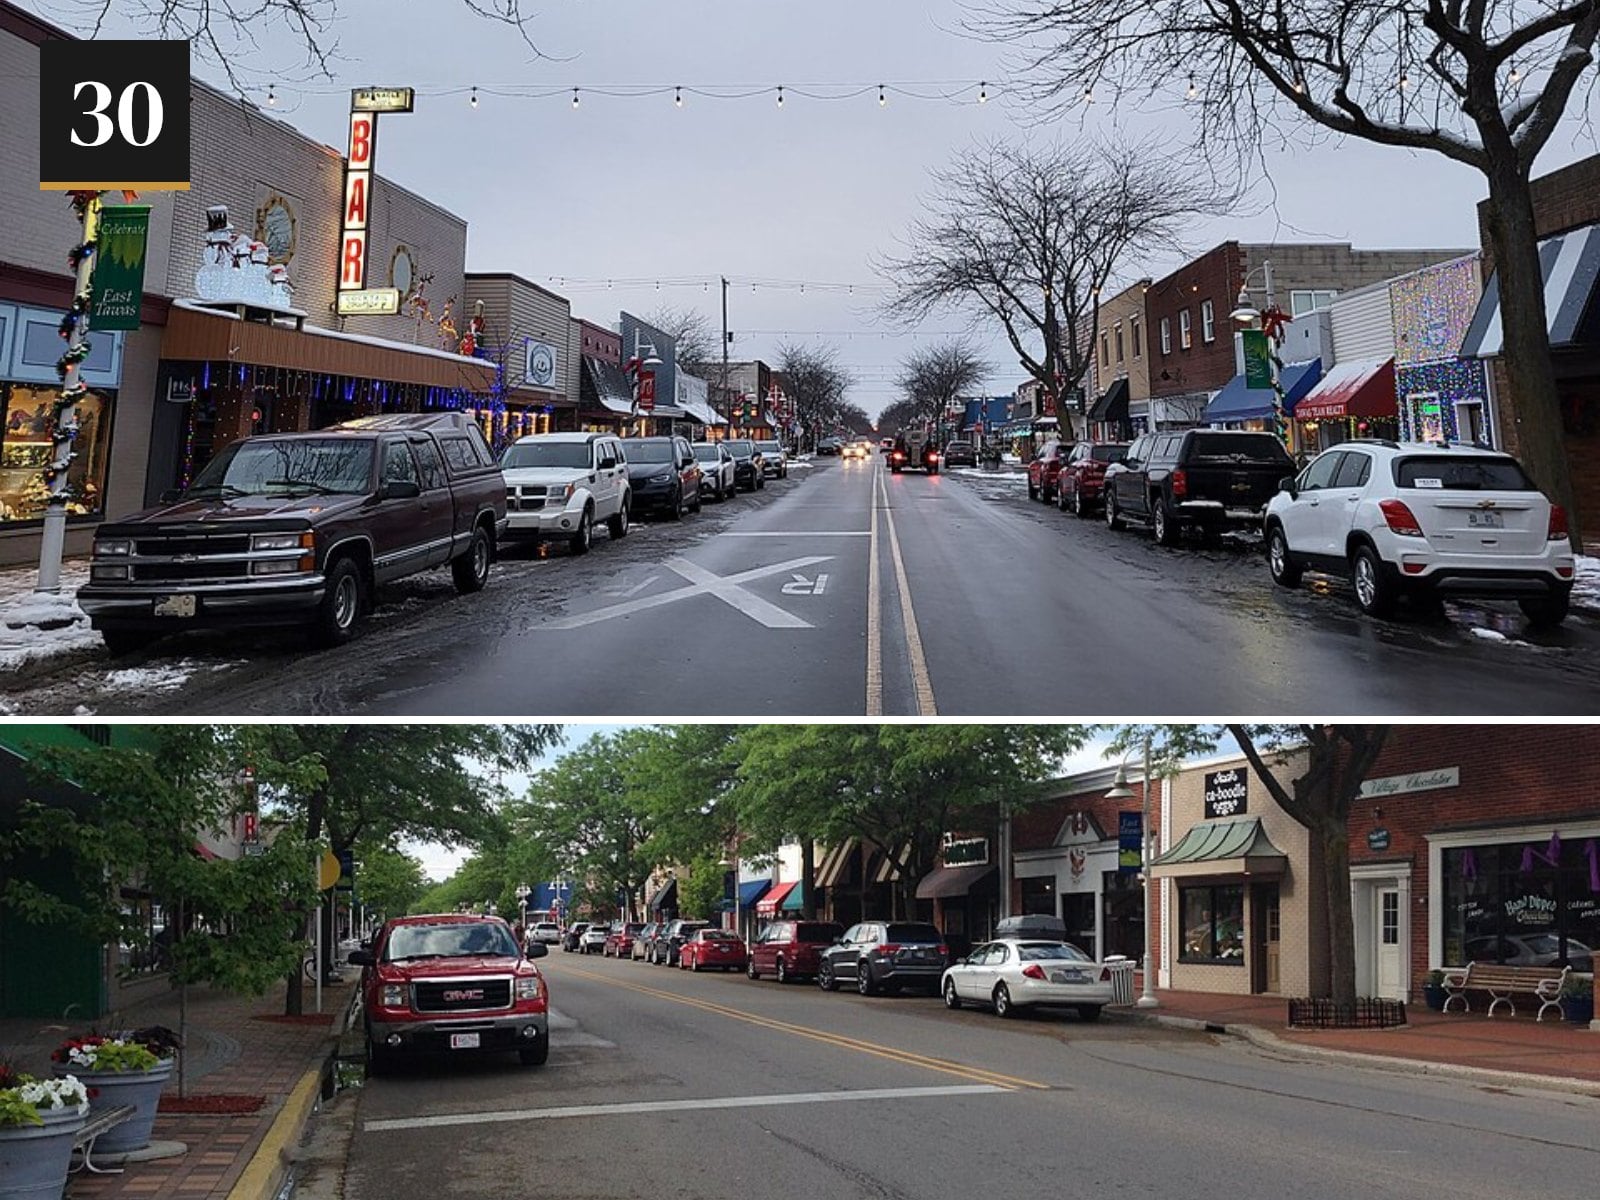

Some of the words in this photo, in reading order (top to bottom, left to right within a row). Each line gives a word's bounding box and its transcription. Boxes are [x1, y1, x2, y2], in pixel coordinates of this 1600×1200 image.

[343, 119, 371, 283] BAR
[101, 223, 146, 235] Celebrate
[103, 288, 133, 302] East
[95, 301, 137, 316] Tawas
[443, 989, 484, 1001] GMC
